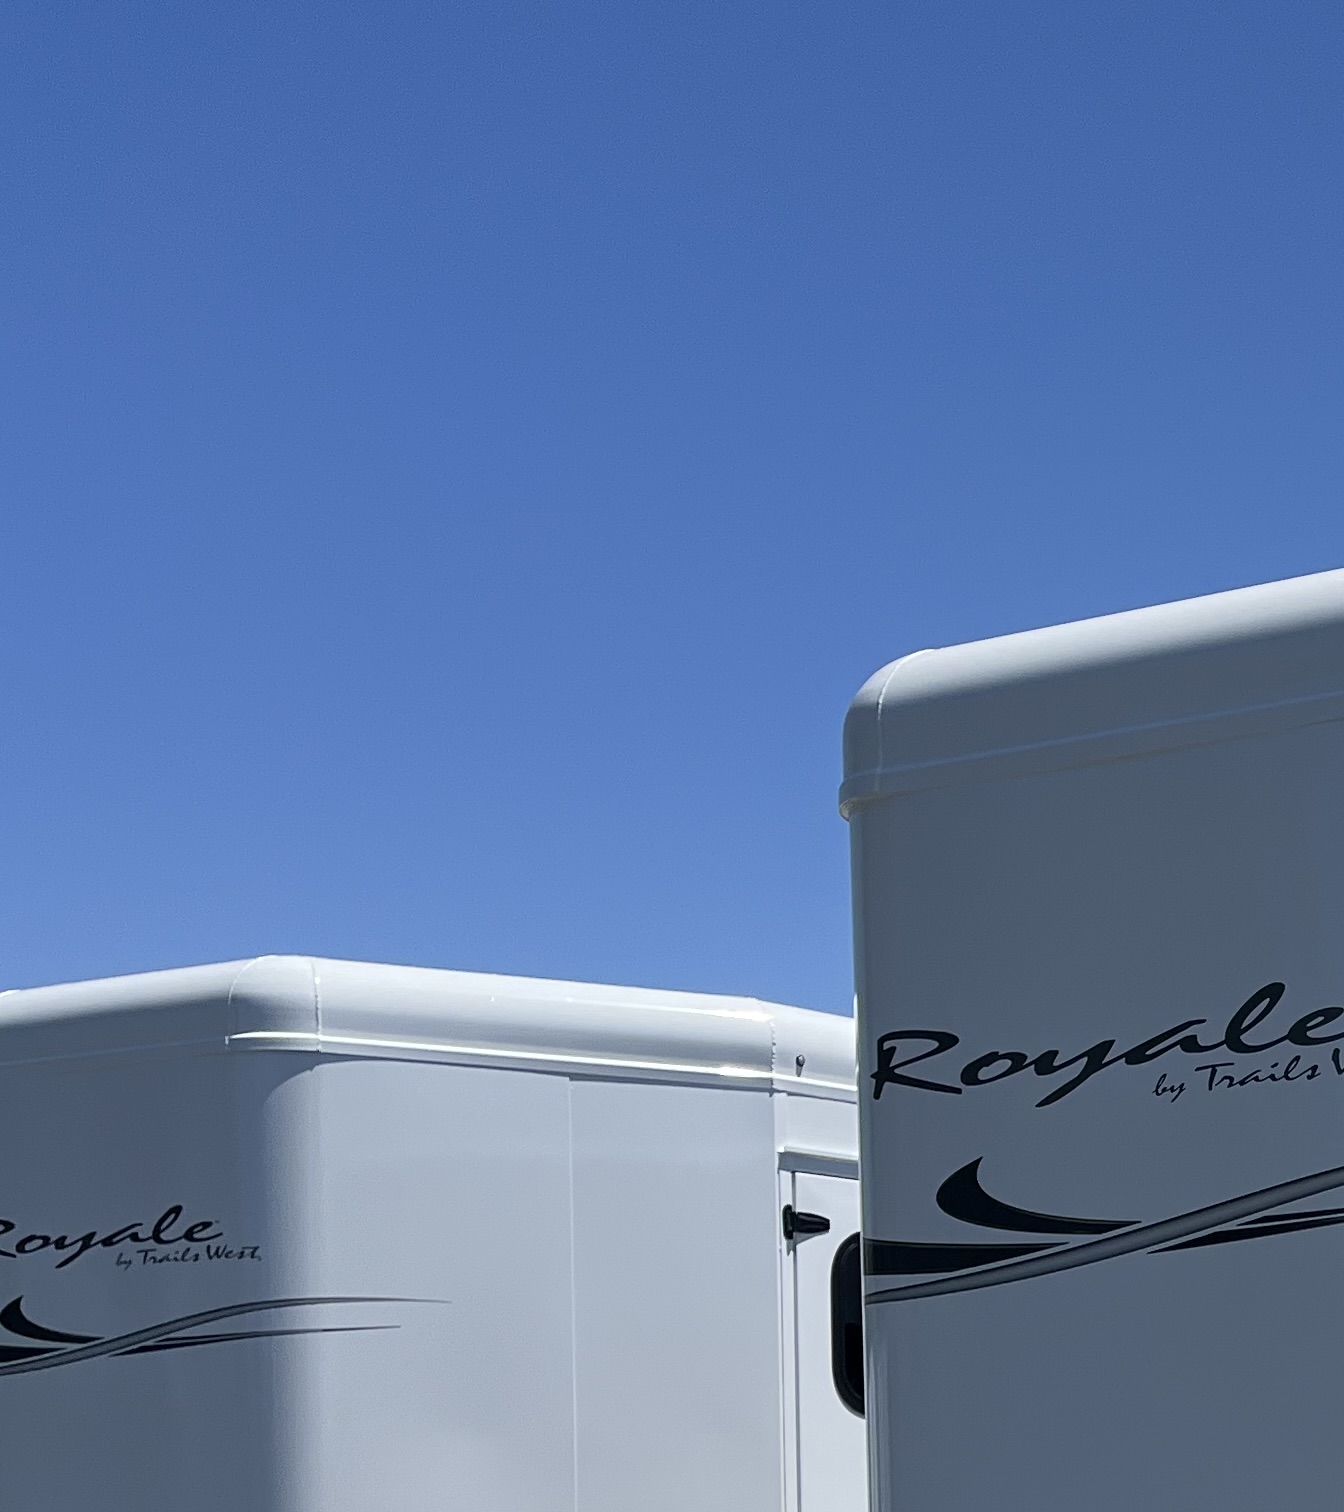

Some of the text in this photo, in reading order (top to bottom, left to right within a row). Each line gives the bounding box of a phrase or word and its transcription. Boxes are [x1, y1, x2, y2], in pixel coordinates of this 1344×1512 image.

[1152, 1073, 1186, 1103] by
[1195, 1055, 1321, 1091] Trails
[116, 1245, 260, 1271] by Trails West
